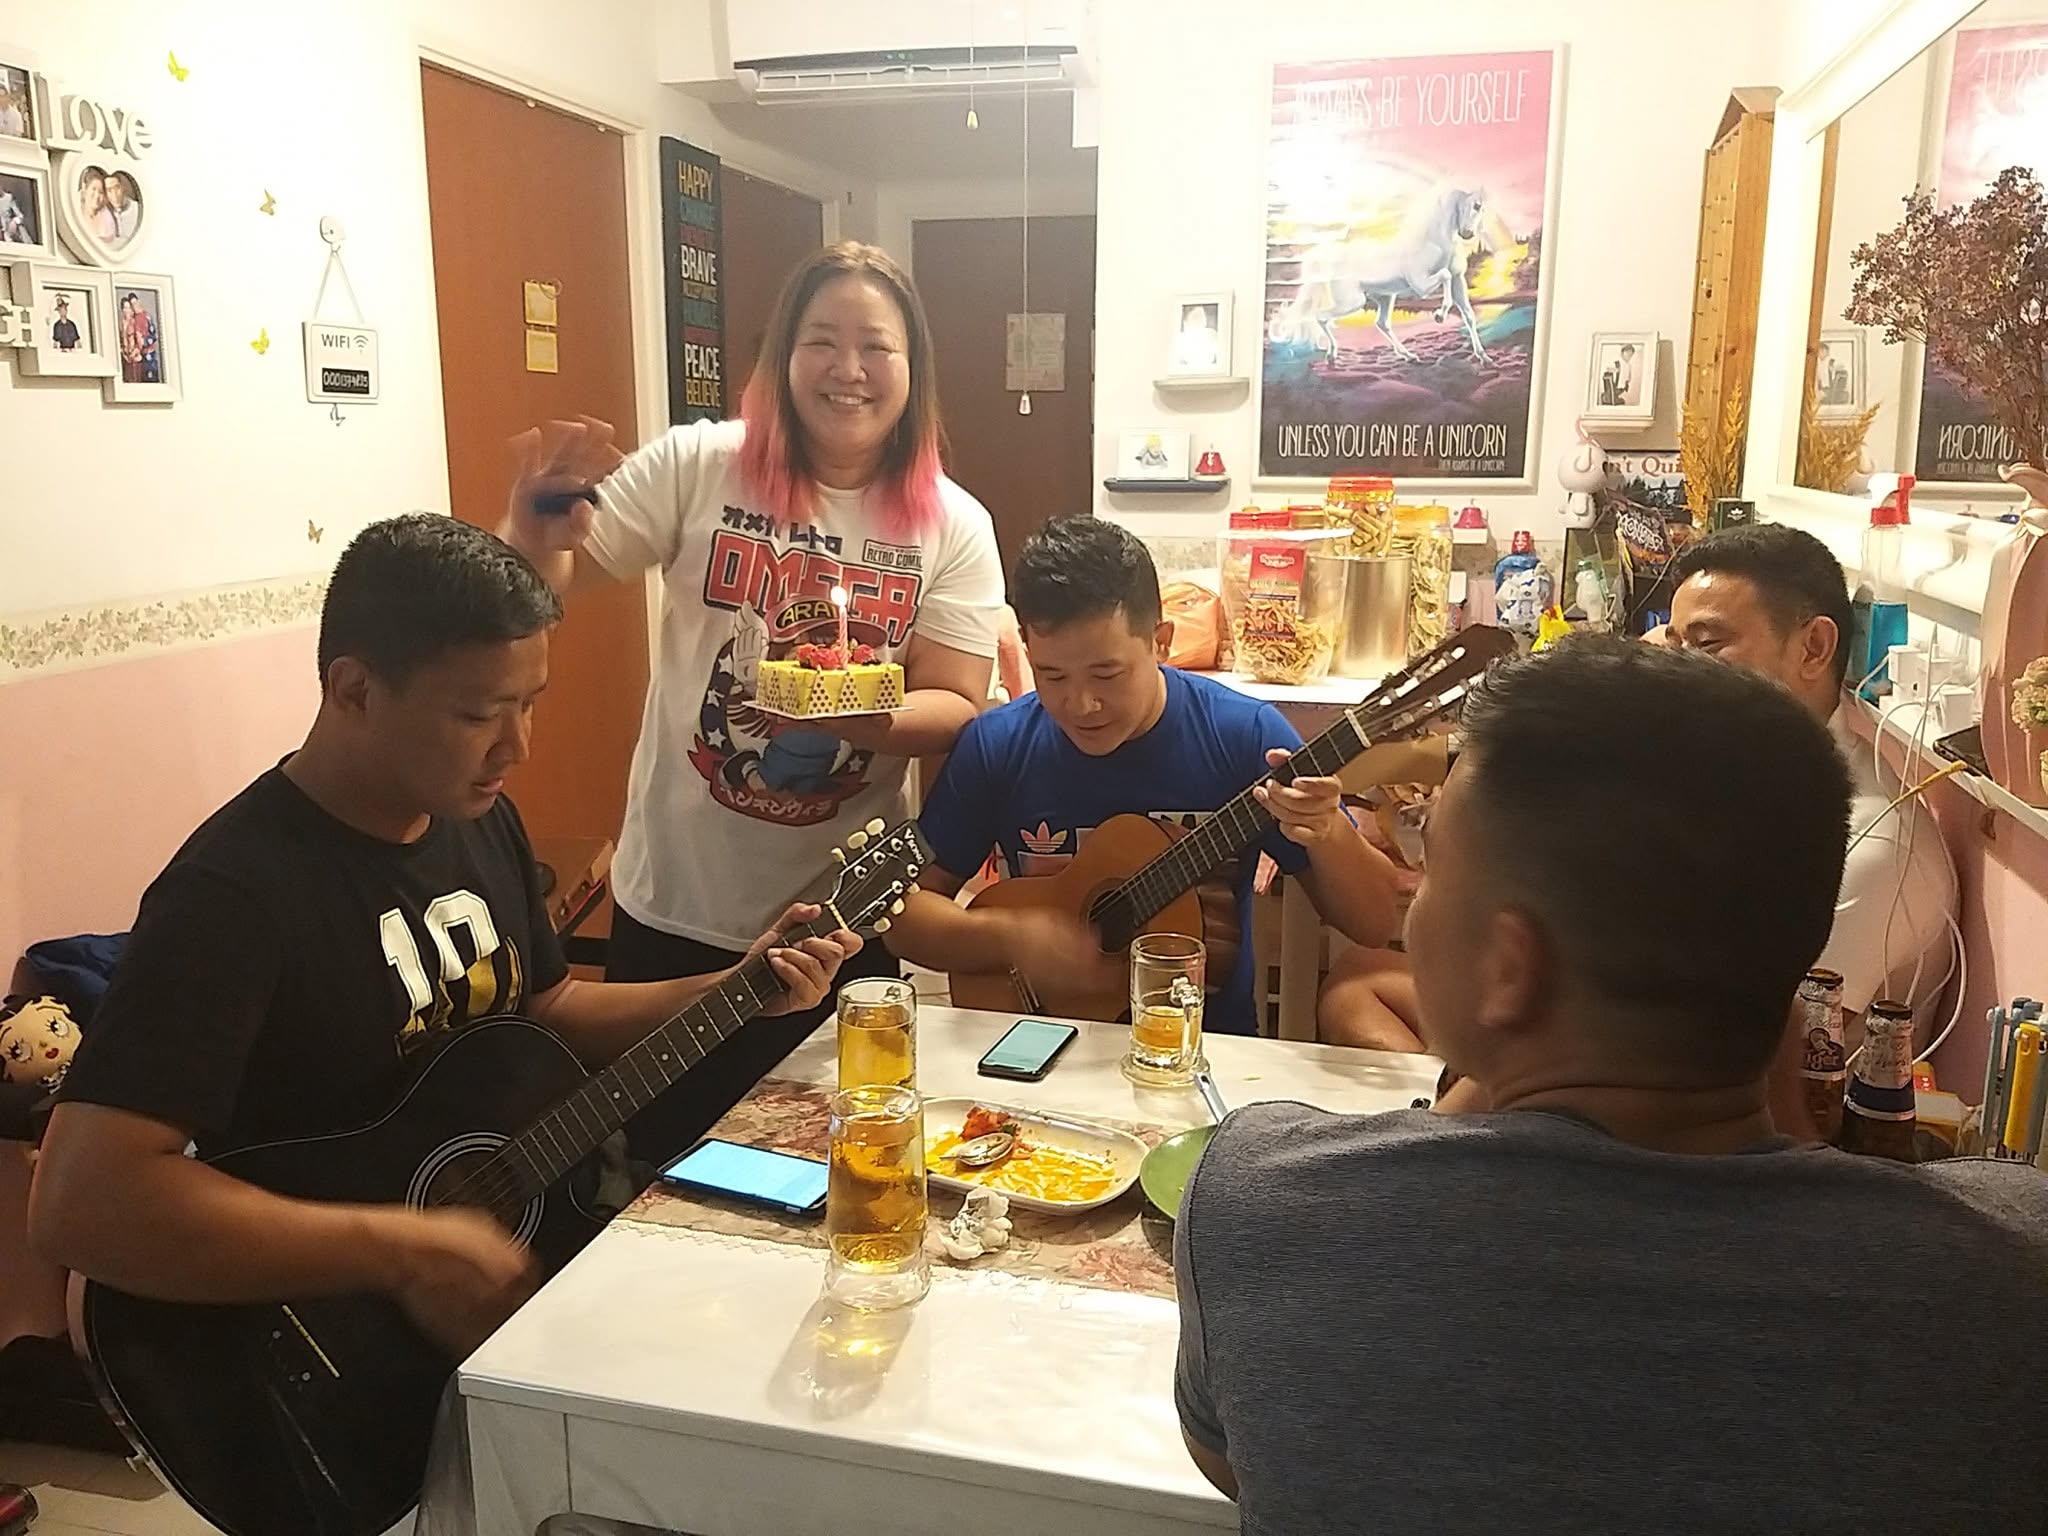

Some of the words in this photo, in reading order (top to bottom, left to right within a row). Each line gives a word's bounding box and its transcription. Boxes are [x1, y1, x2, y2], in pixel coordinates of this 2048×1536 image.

[1380, 75, 1409, 129] BE
[1416, 70, 1531, 127] YOURSELF
[678, 160, 713, 203] HAPPY
[680, 244, 717, 286] BRAVE
[321, 333, 350, 349] WIFI
[685, 343, 721, 380] PEACE
[686, 379, 721, 407] BELIEVE
[1279, 424, 1330, 458] UNLESS
[1335, 424, 1366, 458] YOU
[1370, 424, 1398, 458] CAN
[1403, 424, 1421, 458] BE
[1424, 424, 1435, 458] A
[1439, 424, 1507, 458] UNICORN
[867, 547, 895, 564] RETRO
